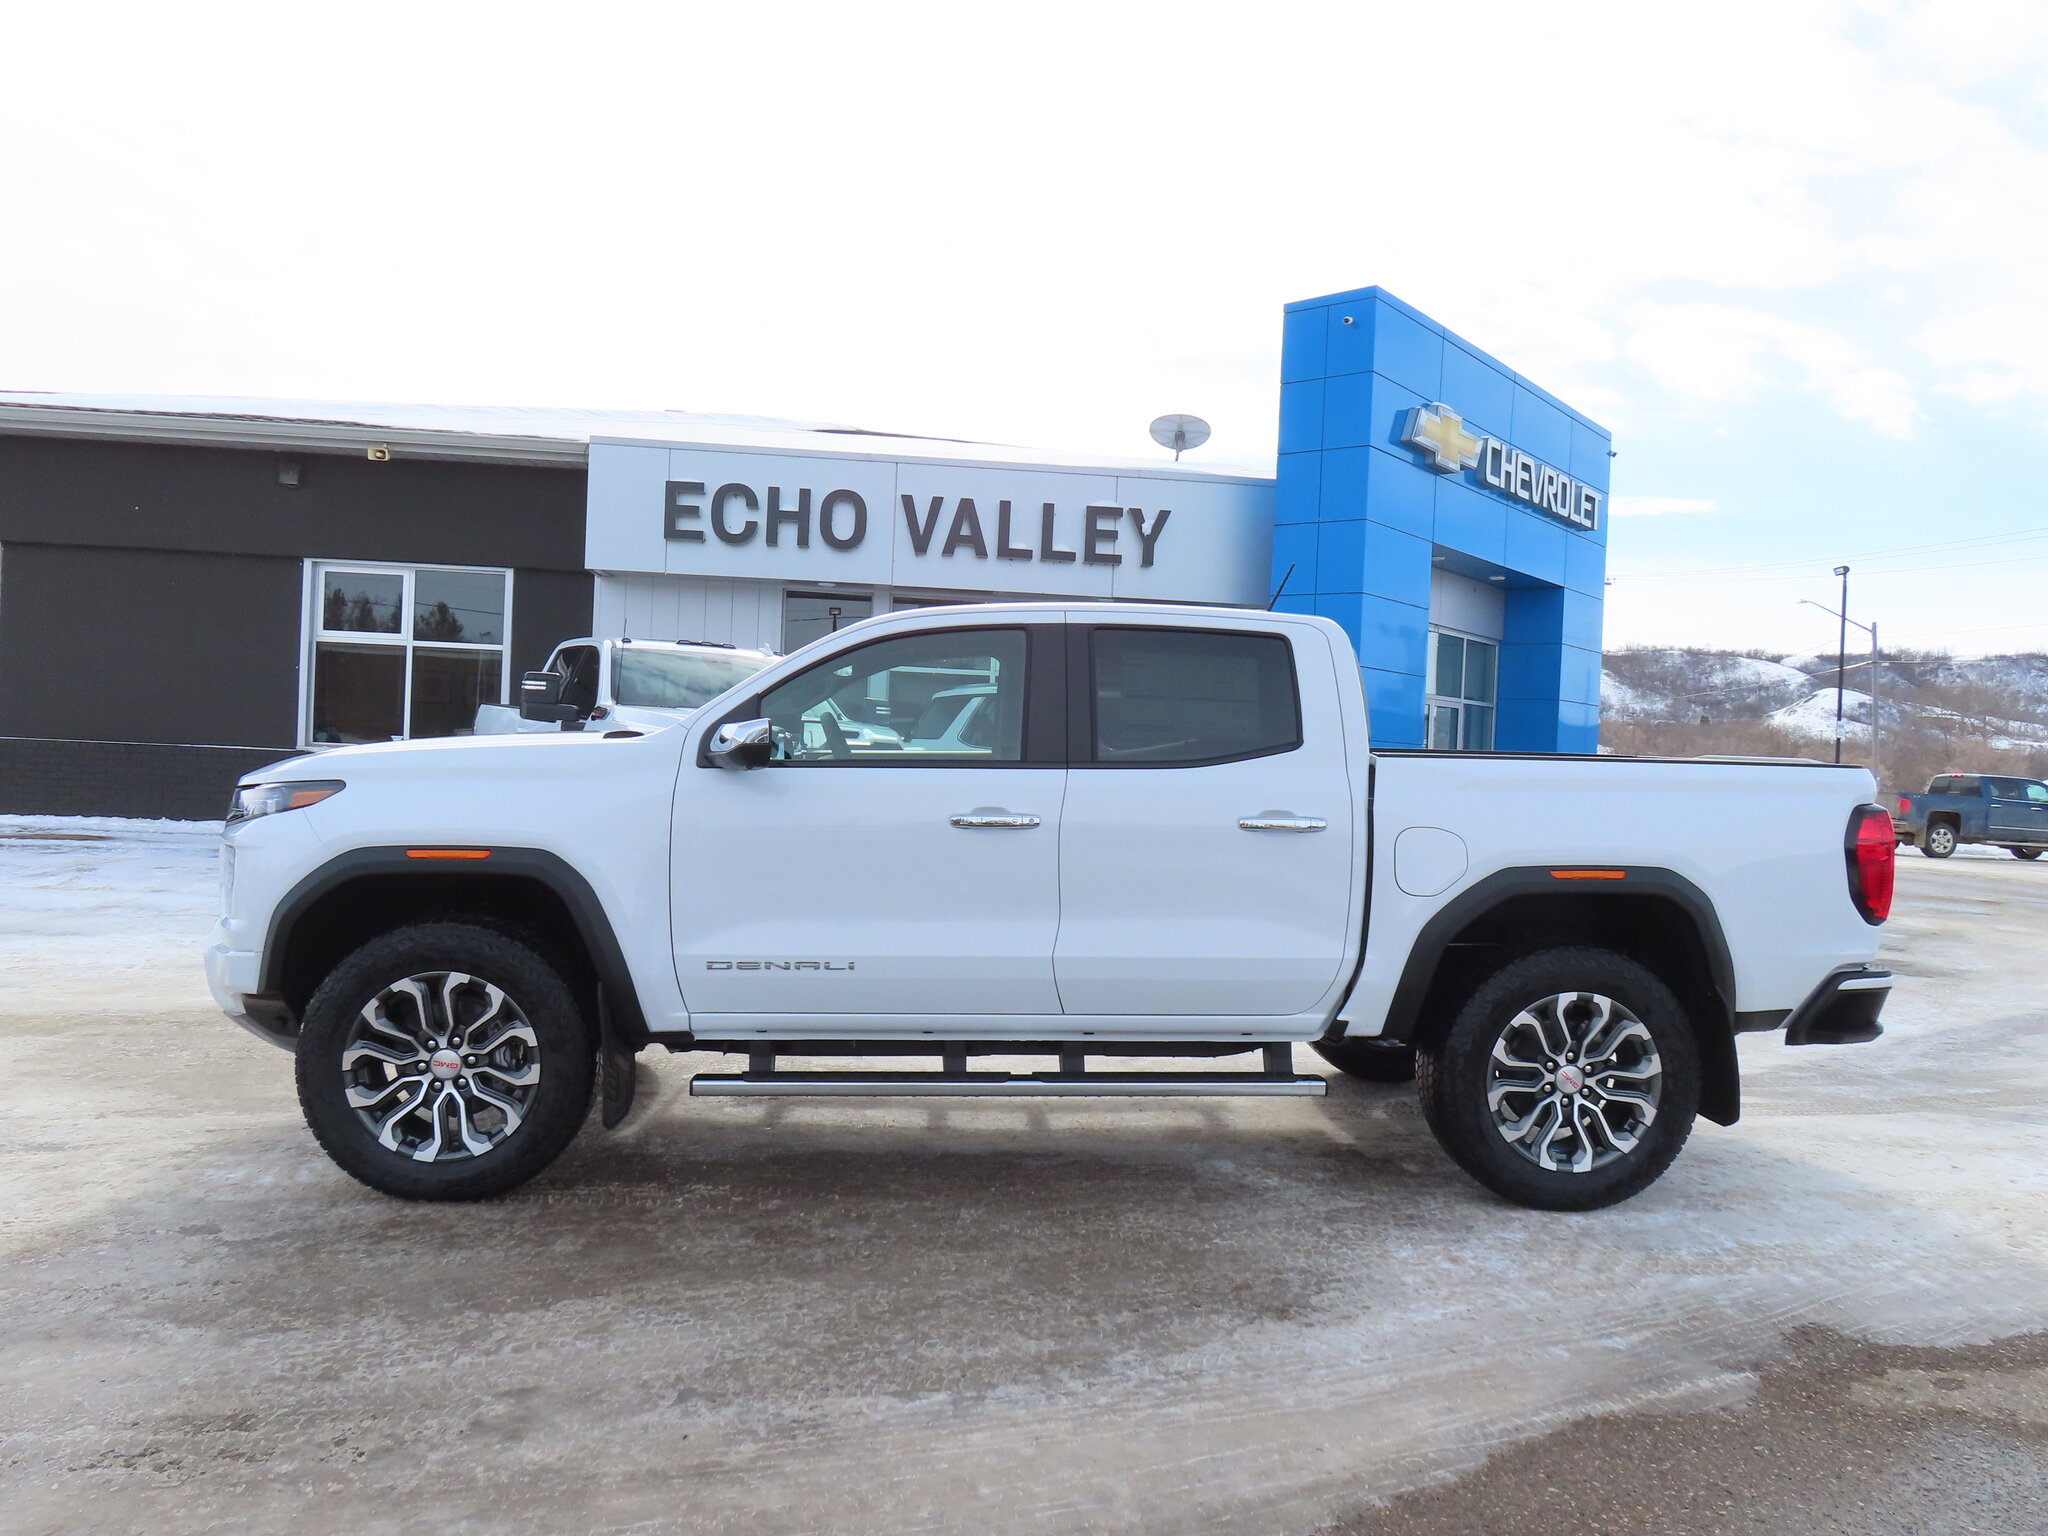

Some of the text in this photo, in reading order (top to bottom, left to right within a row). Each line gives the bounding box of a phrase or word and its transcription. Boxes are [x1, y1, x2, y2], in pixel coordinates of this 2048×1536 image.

[1484, 437, 1603, 531] CHEVROLET
[664, 480, 1172, 568] ECHO VALLEY
[706, 960, 855, 971] DENALI
[433, 1060, 459, 1069] GMC
[1561, 1070, 1580, 1089] GMC
